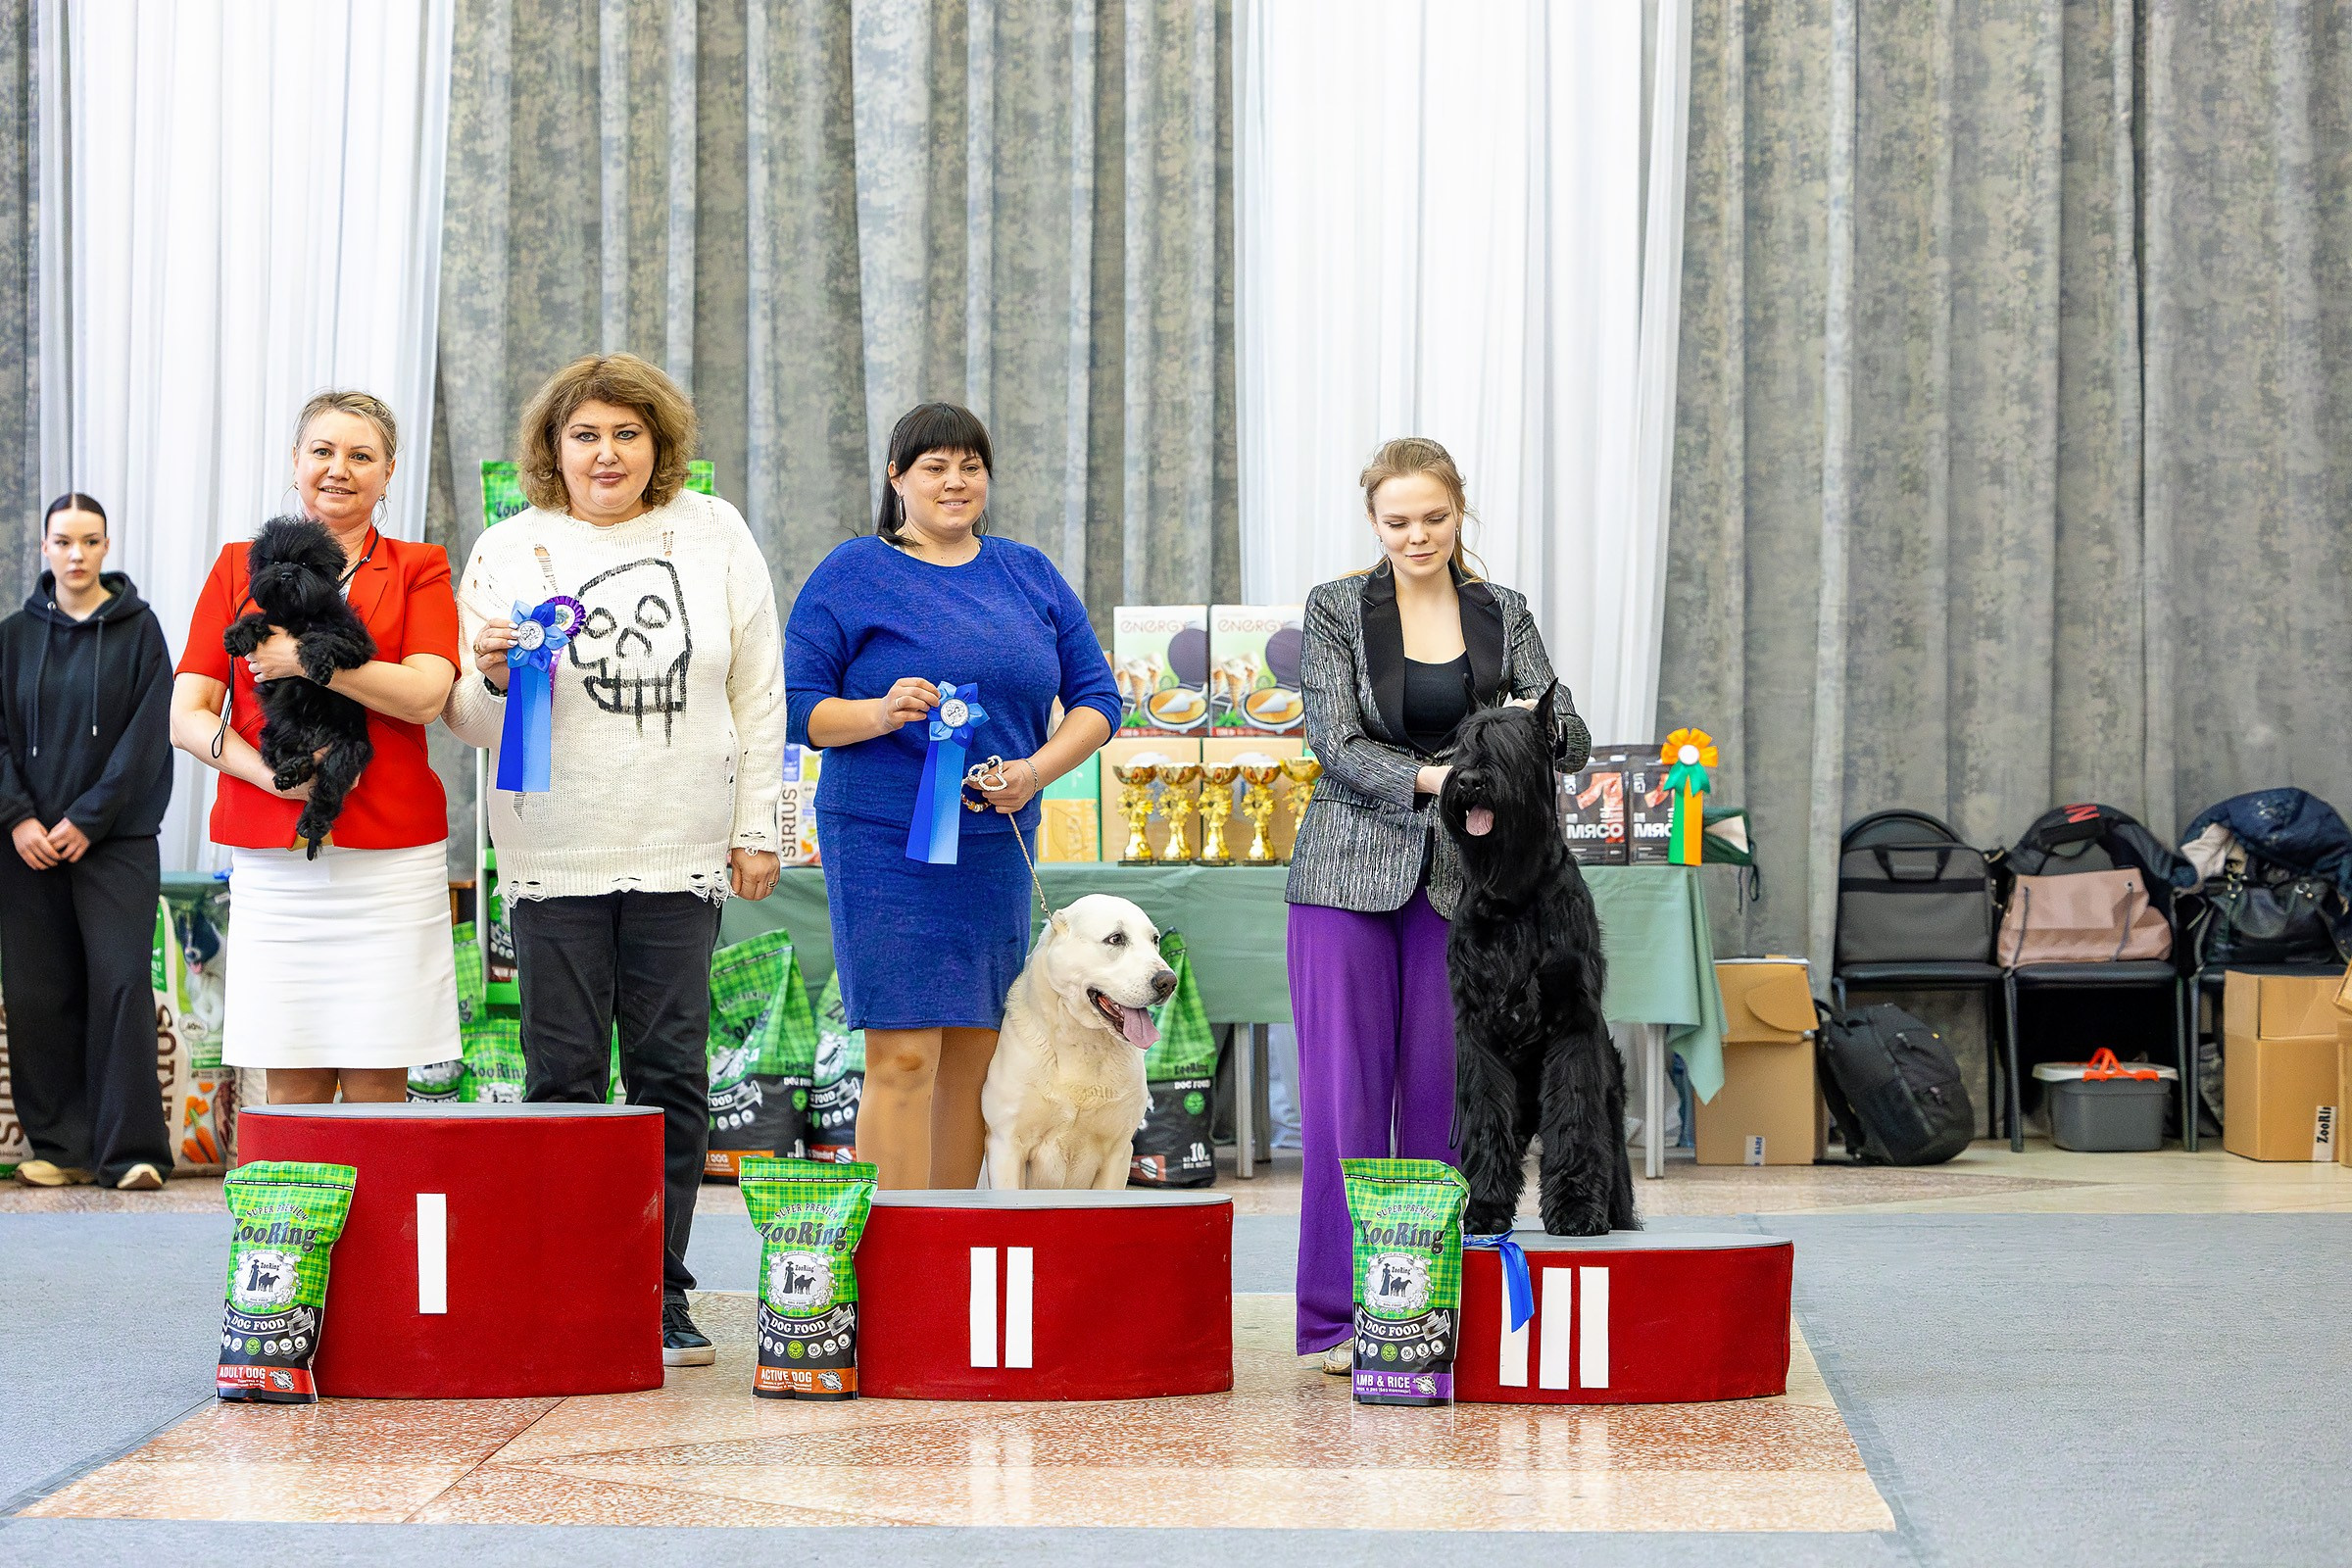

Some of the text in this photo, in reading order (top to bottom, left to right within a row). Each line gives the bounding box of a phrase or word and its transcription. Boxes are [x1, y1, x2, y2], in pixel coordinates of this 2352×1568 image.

[781, 788, 798, 858] SIRIUS
[1633, 822, 1674, 838] МЯС
[1566, 823, 1624, 839] МЯСО
[246, 1205, 274, 1218] SUPER
[774, 1203, 803, 1219] SUPER
[1376, 1204, 1402, 1219] SUPER
[760, 1221, 849, 1252] ZooRing
[260, 1261, 280, 1271] ZooRing
[795, 1264, 815, 1273] ZooRing
[1392, 1266, 1411, 1275] ZooRing
[231, 1315, 286, 1331] DOG FOOD
[770, 1317, 826, 1334] DOG FOOD
[1364, 1320, 1421, 1337] DOG FOOD
[219, 1366, 266, 1380] ADULT DOG
[760, 1368, 790, 1381] ACTIVE
[792, 1371, 812, 1383] DOG
[1376, 1375, 1385, 1387] &
[1387, 1376, 1411, 1389] RICE
